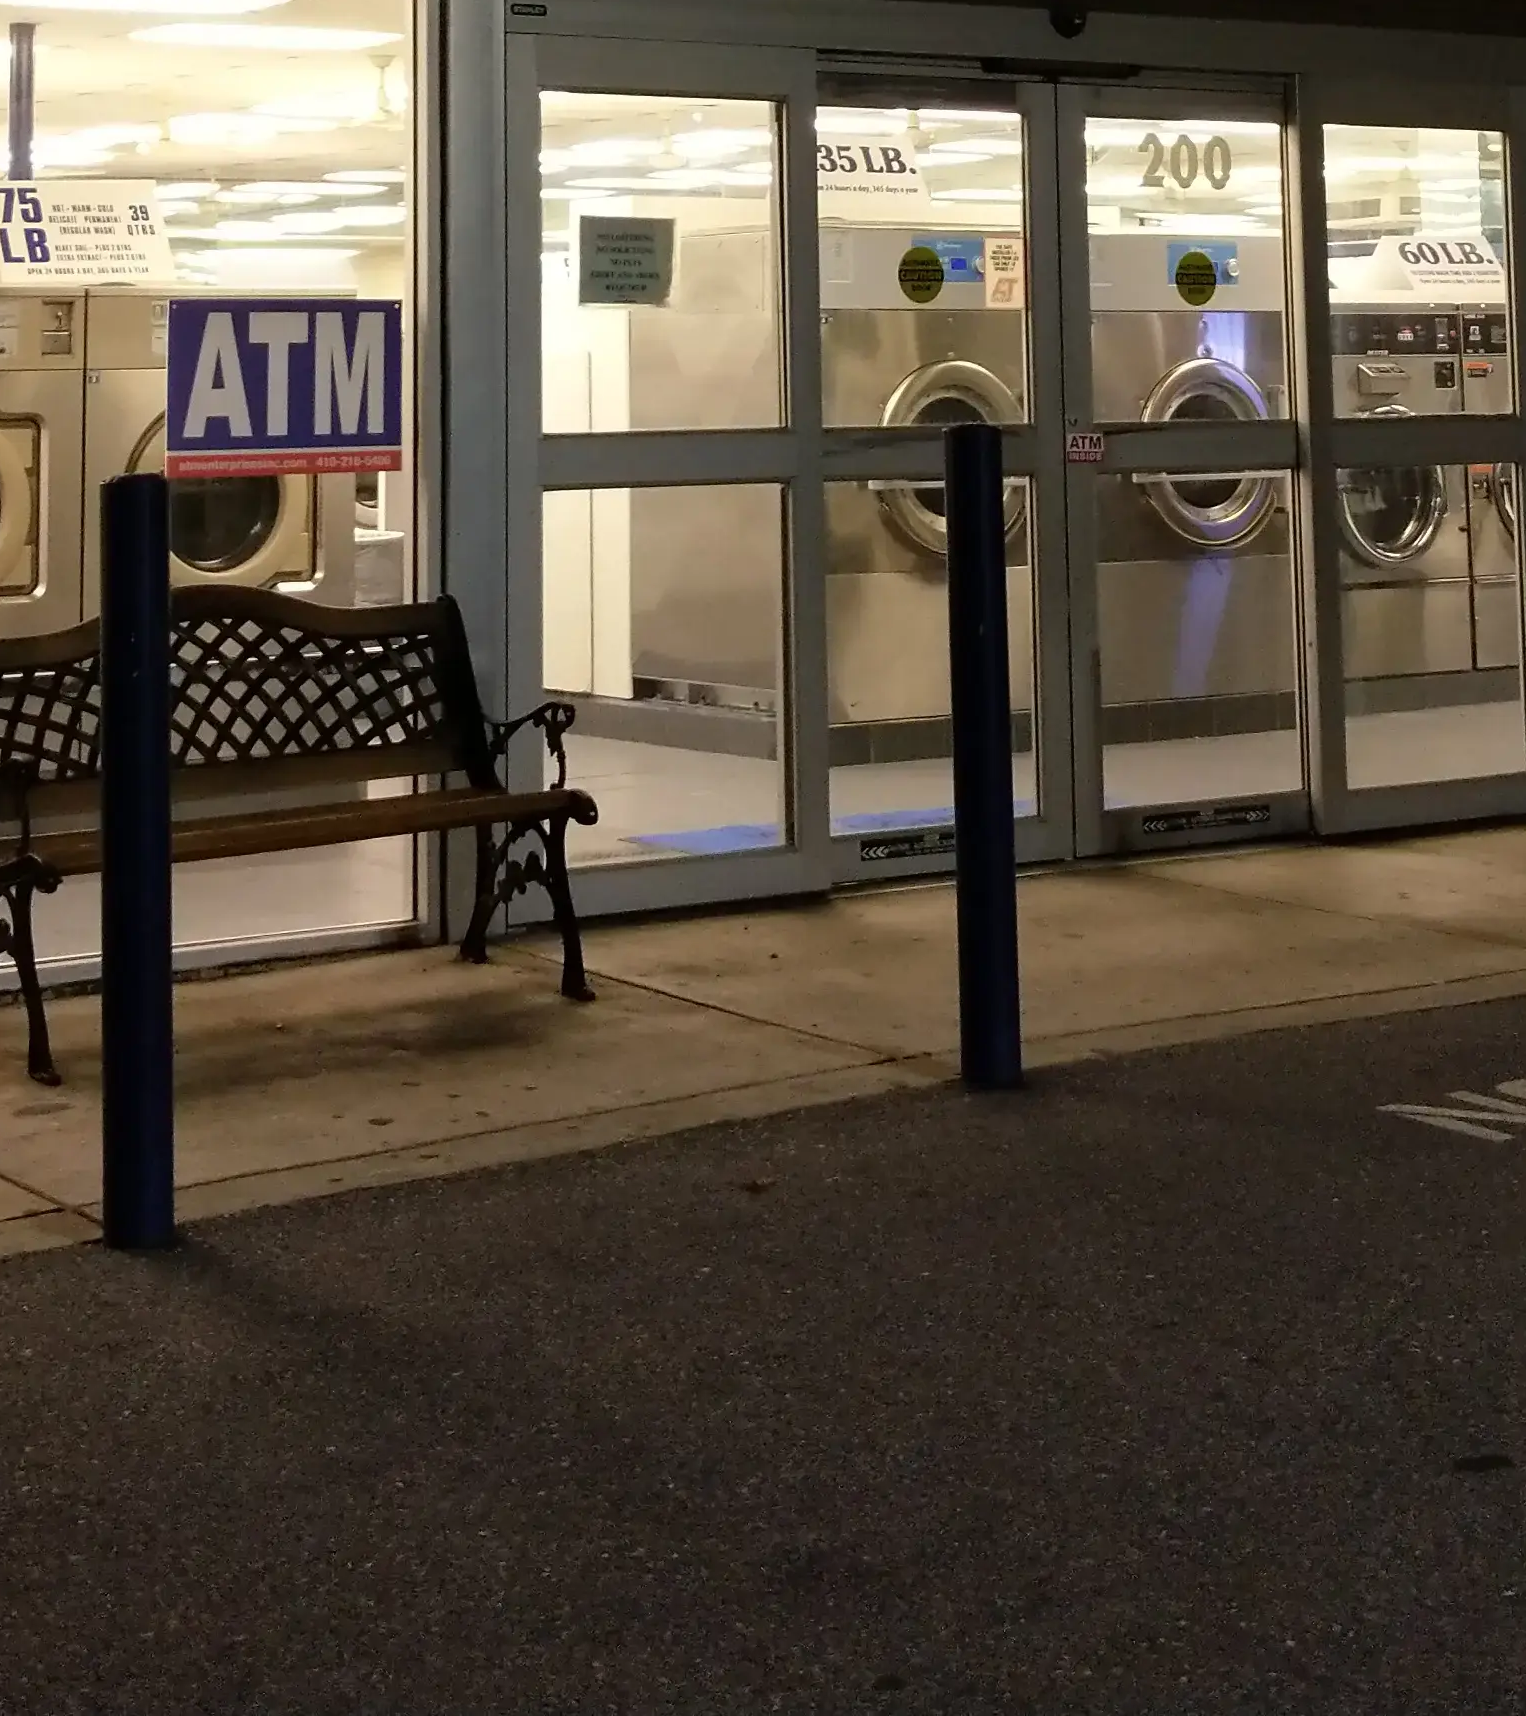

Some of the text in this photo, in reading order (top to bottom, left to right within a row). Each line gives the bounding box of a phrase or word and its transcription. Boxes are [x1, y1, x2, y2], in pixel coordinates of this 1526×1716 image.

[858, 145, 917, 175] LB.
[1137, 132, 1233, 190] 200
[127, 204, 150, 222] 39
[1397, 241, 1495, 265] 60 LB.
[182, 311, 386, 438] ATM
[1069, 435, 1103, 450] ATM
[1068, 451, 1103, 462] INSIDE
